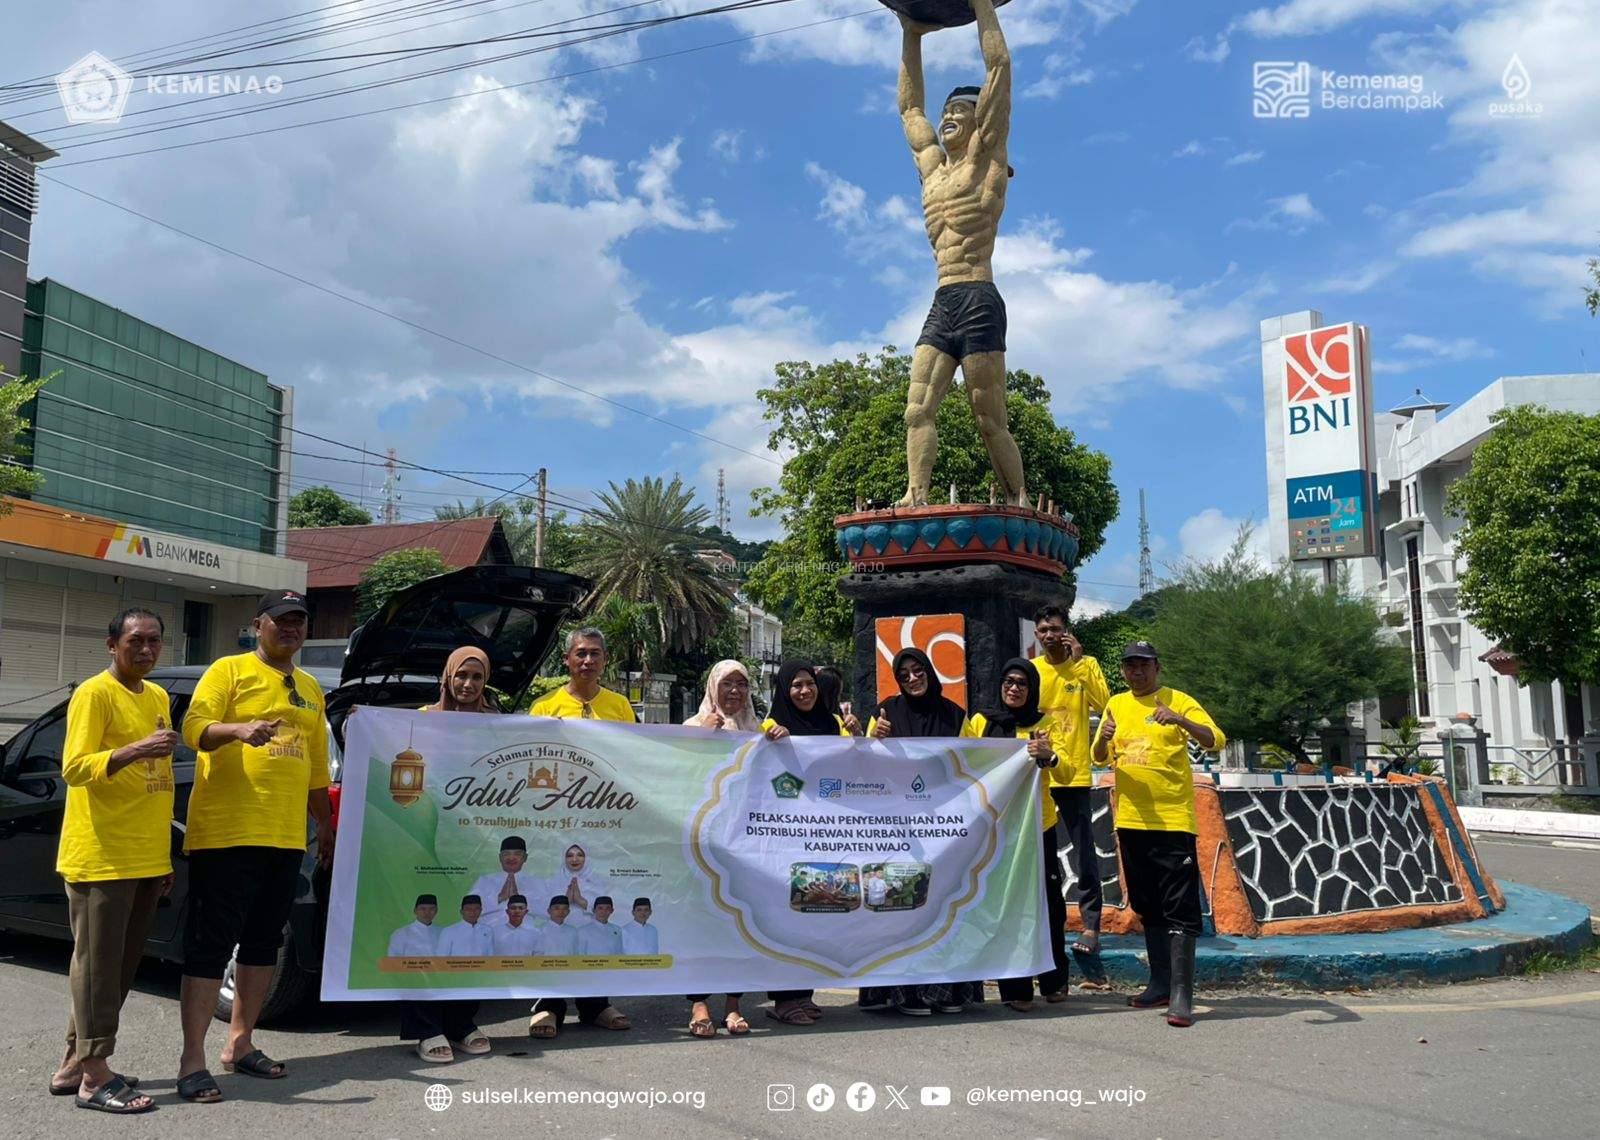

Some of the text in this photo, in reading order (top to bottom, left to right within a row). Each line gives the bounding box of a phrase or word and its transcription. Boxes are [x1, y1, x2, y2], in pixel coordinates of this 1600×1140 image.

[1289, 397, 1350, 435] BNI
[1293, 485, 1333, 504] ATM
[1330, 497, 1356, 518] 24
[443, 775, 640, 811] Idul Adha
[845, 782, 885, 790] Kemenag
[749, 812, 964, 825] PELAKSANAAN PENYEMBELIHAN DAN
[746, 826, 968, 838] DISTRIBUSI HEWAN KURBAN KEMENAG
[804, 842, 911, 852] KABUPATEN WAJO
